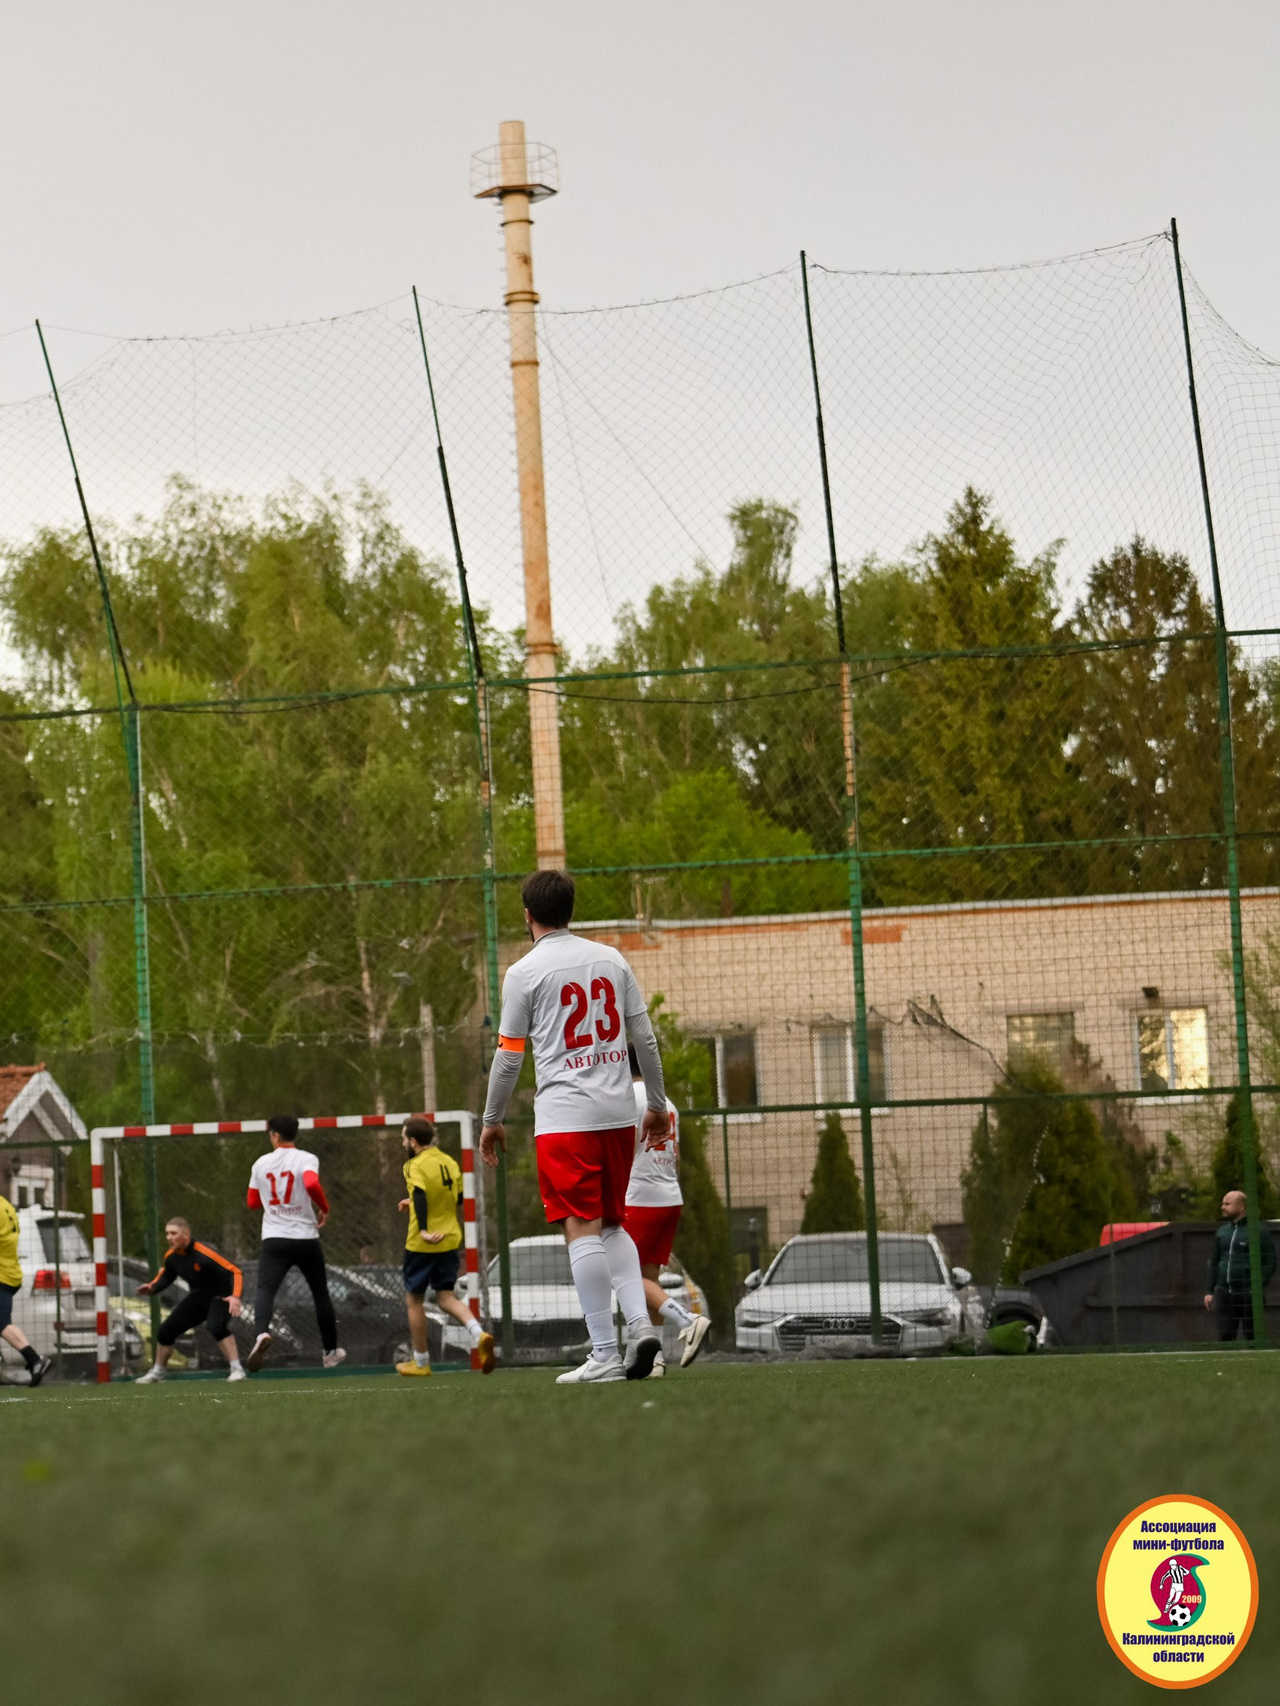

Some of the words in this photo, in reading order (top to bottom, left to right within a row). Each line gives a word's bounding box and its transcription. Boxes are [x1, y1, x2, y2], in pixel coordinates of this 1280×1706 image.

[560, 976, 621, 1050] 23
[563, 1050, 627, 1070] АВТОТОР
[266, 1170, 295, 1205] 17
[439, 1164, 453, 1191] 4
